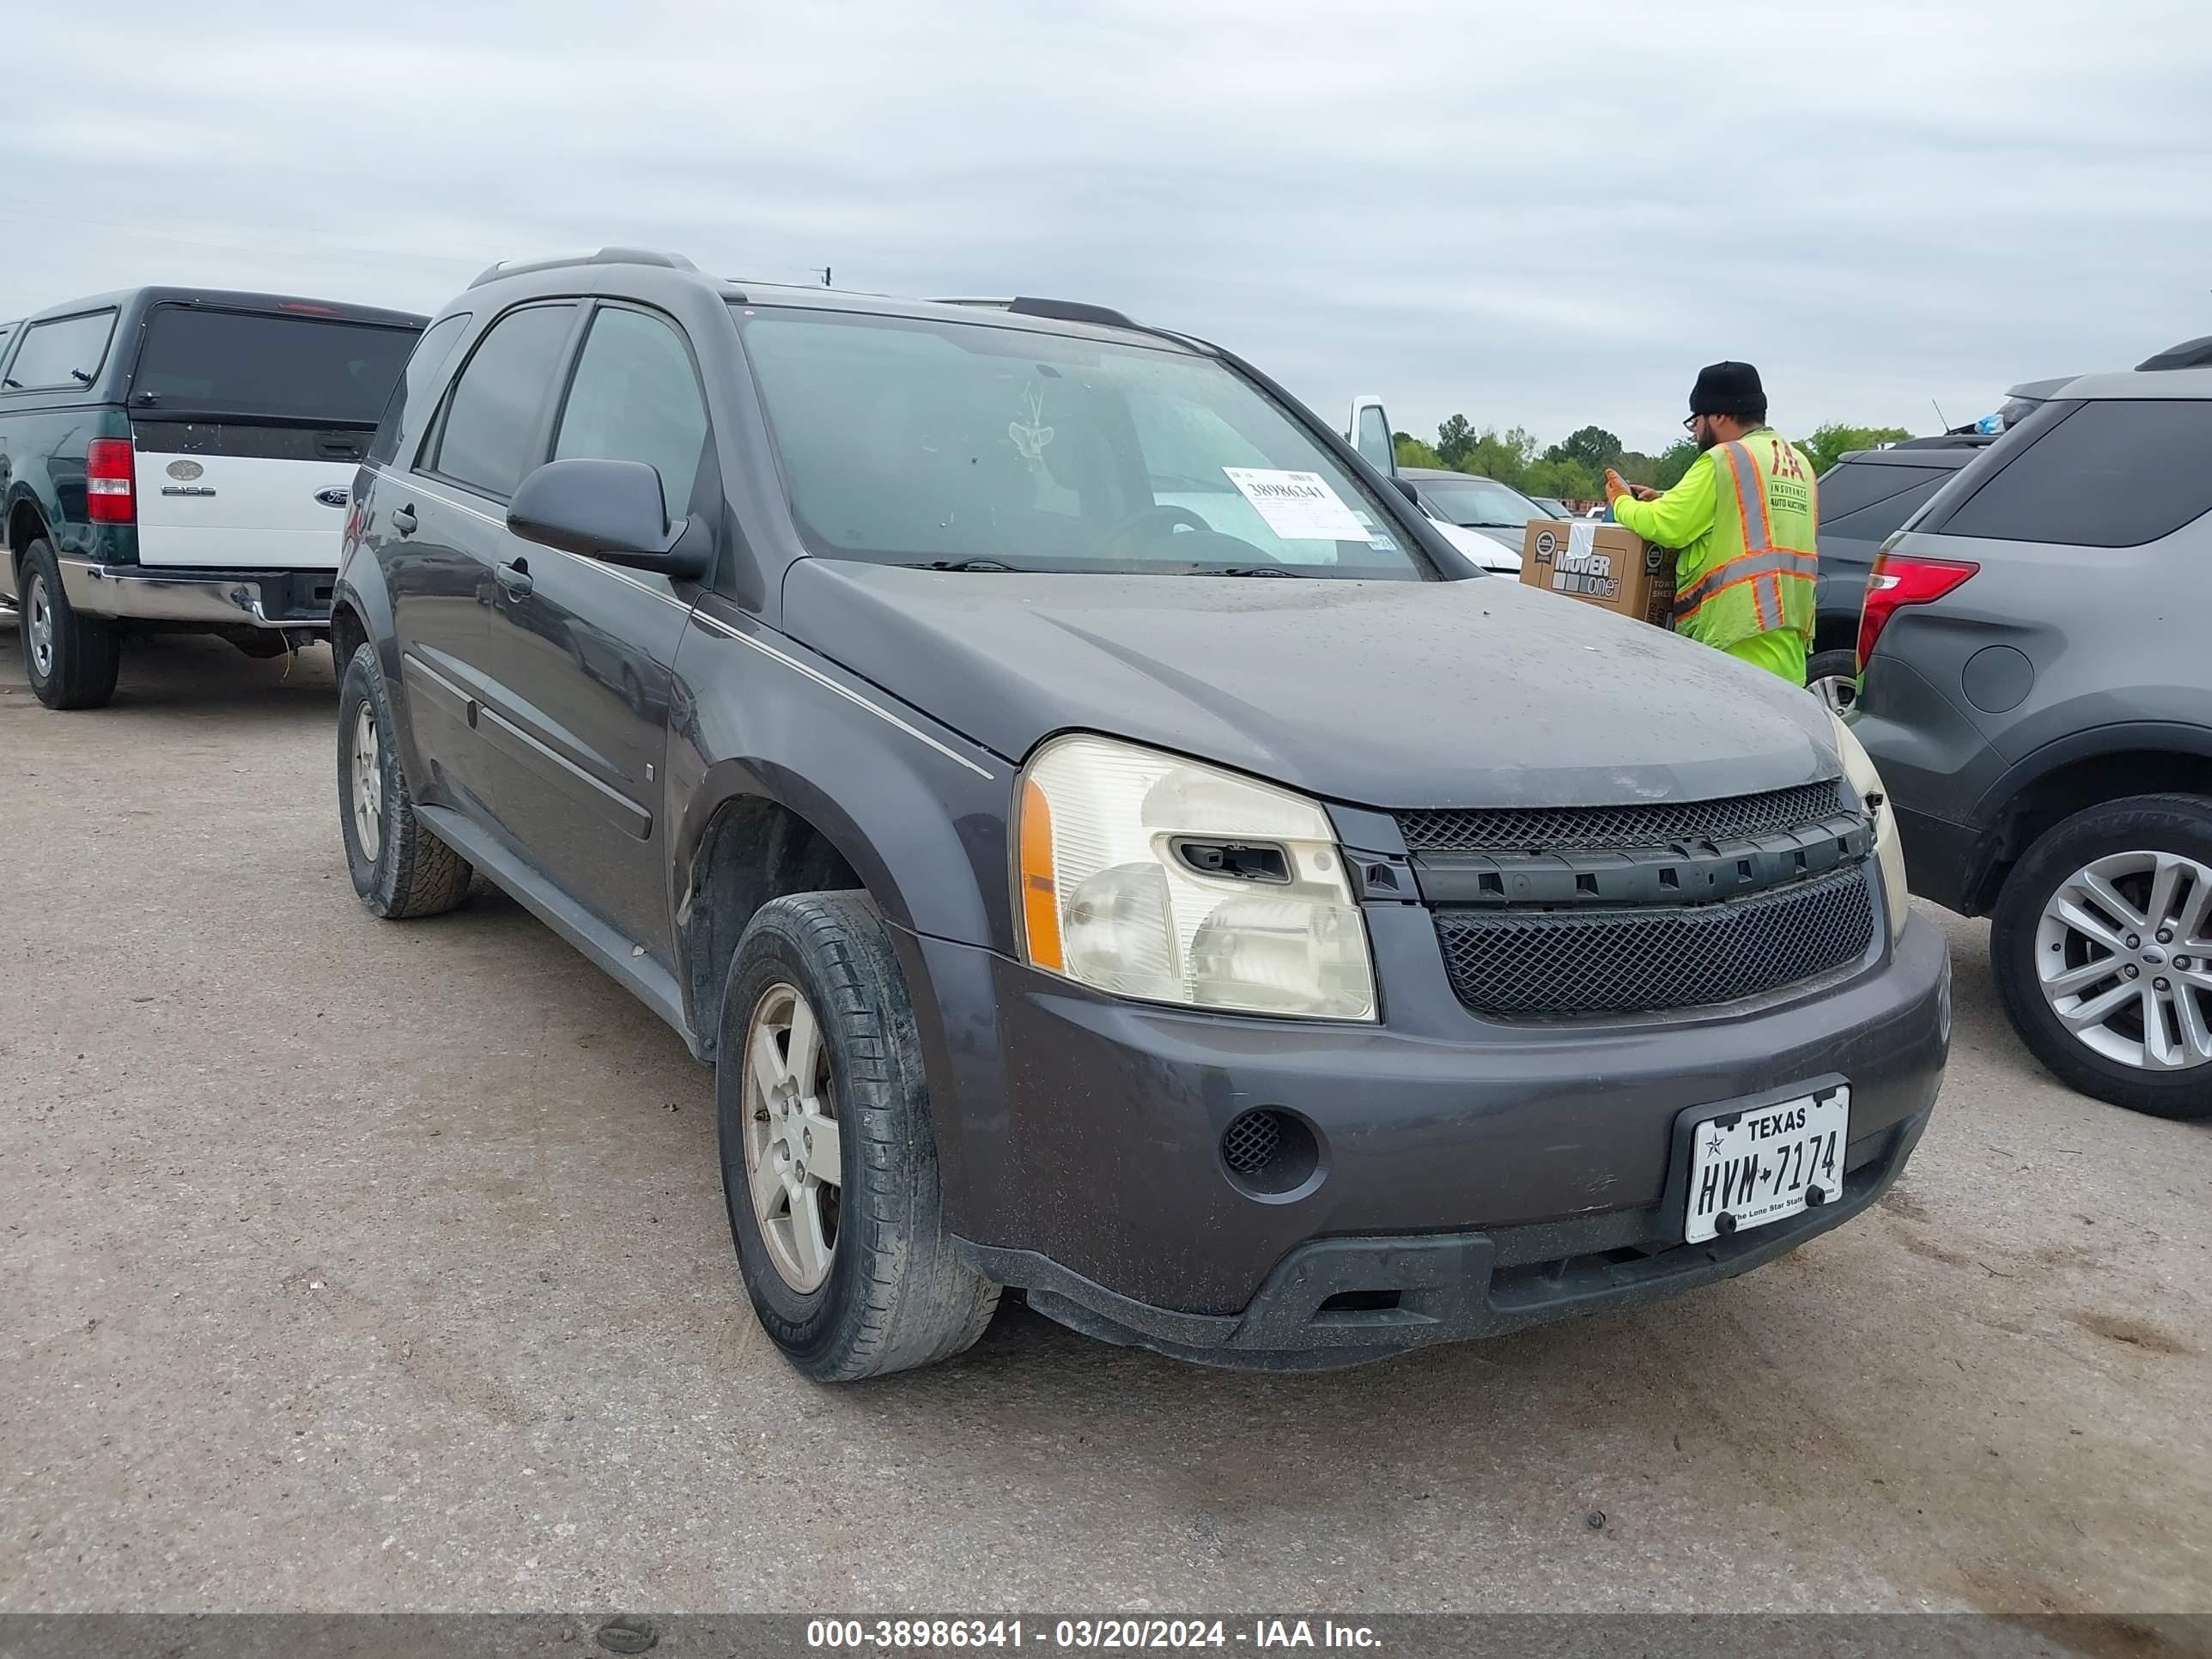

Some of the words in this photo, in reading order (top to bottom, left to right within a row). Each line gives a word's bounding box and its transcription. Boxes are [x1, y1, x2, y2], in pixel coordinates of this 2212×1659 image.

[1248, 483, 1326, 498] 38986341
[1771, 483, 1807, 499] INSURANCE
[1771, 497, 1786, 508] AUTO
[1787, 500, 1807, 513] AUCTIONS
[1554, 550, 1611, 577] MOVER
[1588, 576, 1614, 597] one
[1748, 1108, 1806, 1141] TEXAS
[1749, 1208, 1768, 1218] Lone
[1769, 1202, 1784, 1212] Star
[1786, 1196, 1804, 1207] State
